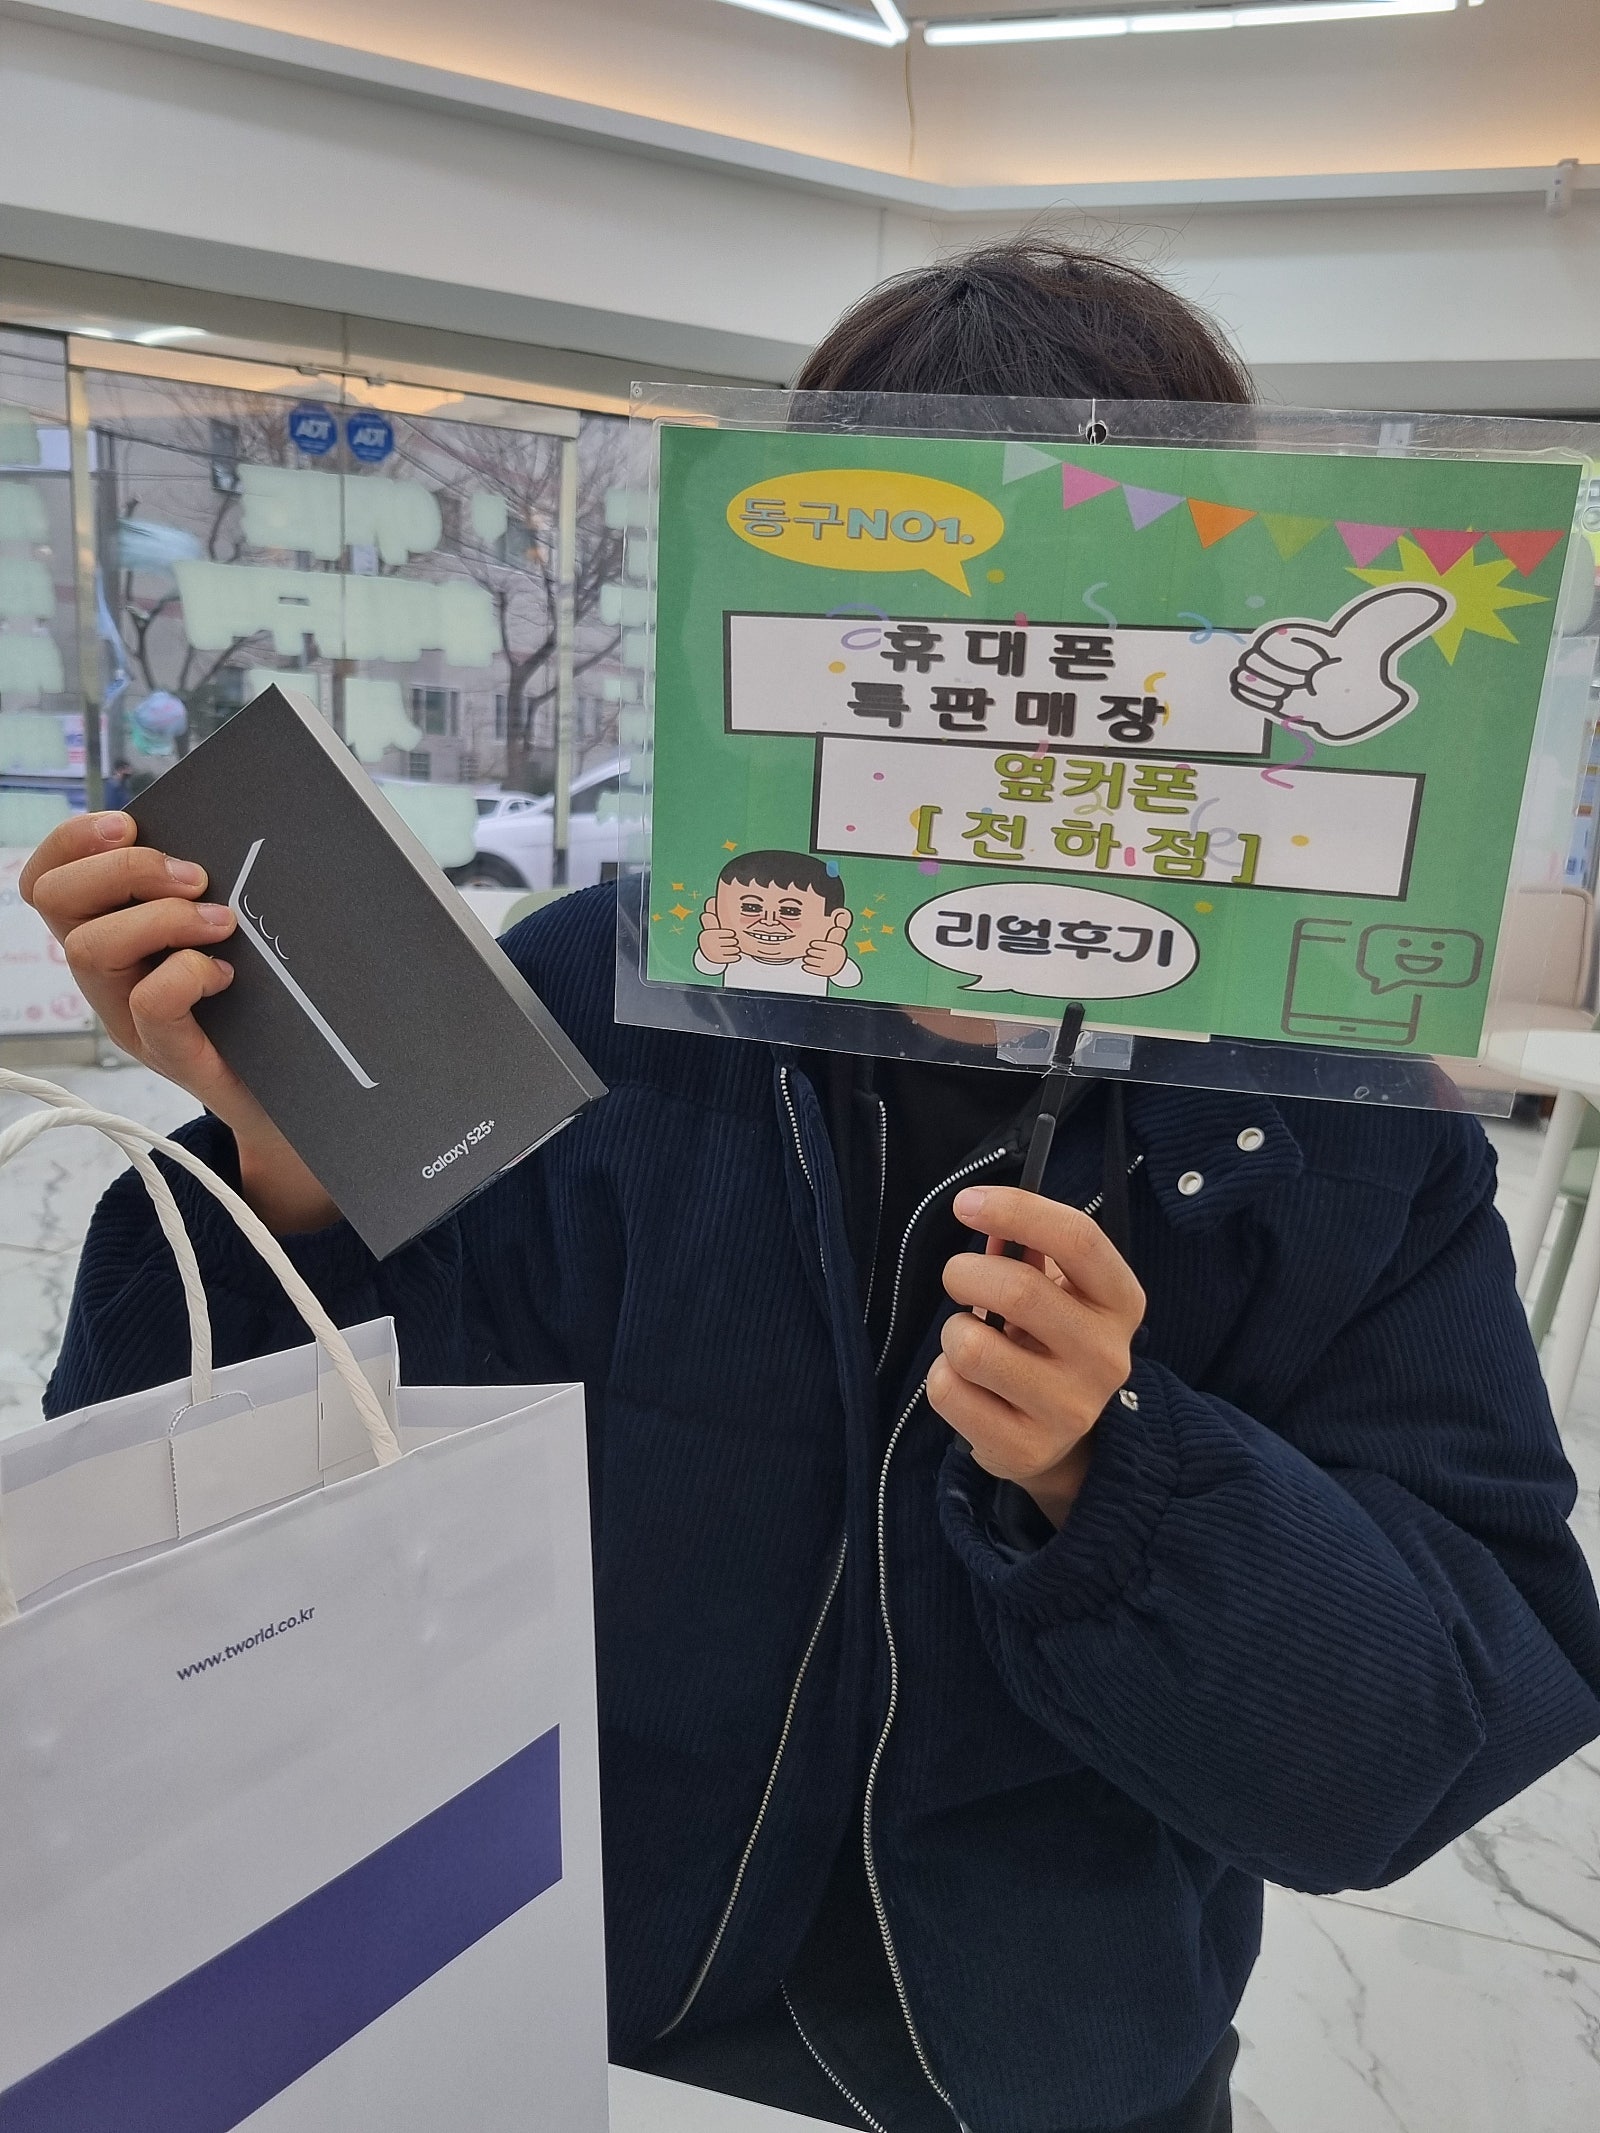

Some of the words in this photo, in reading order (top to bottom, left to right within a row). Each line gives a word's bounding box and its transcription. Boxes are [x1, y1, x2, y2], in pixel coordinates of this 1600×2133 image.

[295, 419, 331, 440] ADT
[352, 427, 387, 448] ADT
[994, 752, 1199, 814] 옆커폰
[935, 910, 1174, 968] 리얼후기
[421, 1139, 470, 1179] Galaxy
[466, 1119, 496, 1145] S25+
[176, 1606, 316, 1681] www.tworld.co.kr
